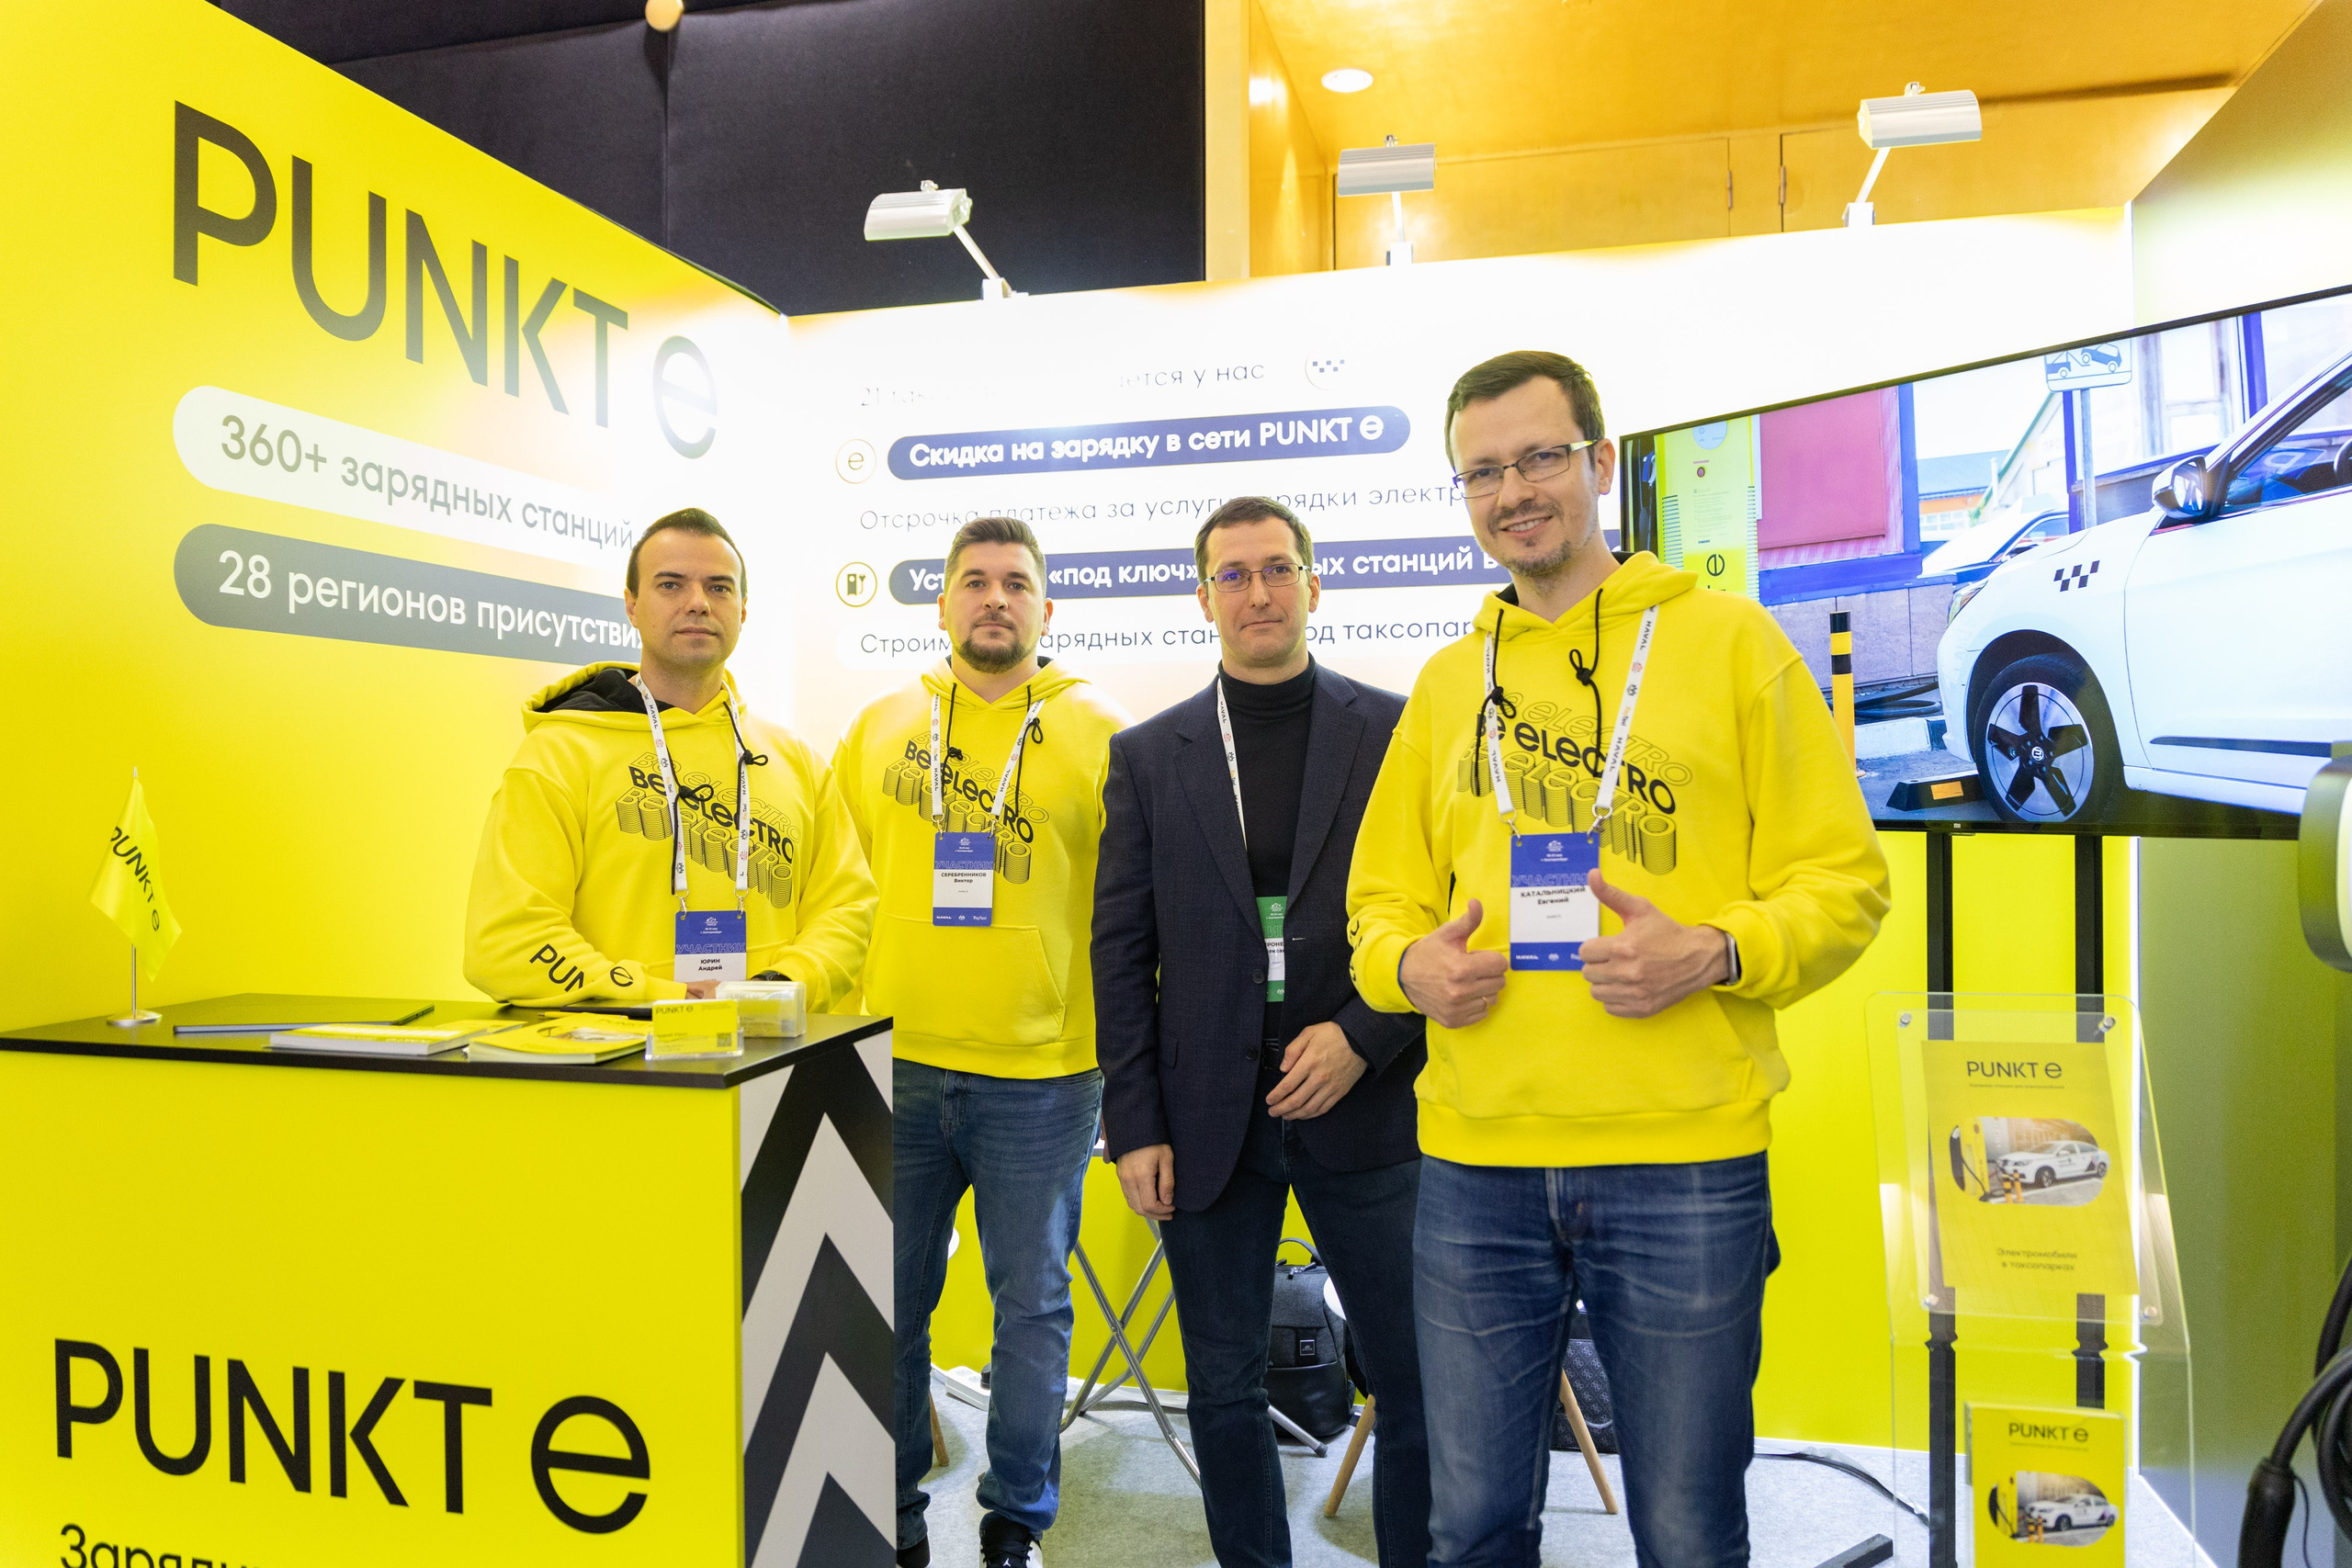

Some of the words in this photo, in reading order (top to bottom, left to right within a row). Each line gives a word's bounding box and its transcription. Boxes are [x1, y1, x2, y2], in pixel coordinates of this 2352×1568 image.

[174, 99, 628, 429] PUNKT
[652, 334, 718, 459] e
[1193, 368, 1206, 389] у
[1216, 364, 1265, 382] нас
[909, 442, 1004, 468] Скидка
[1012, 440, 1045, 461] на
[1050, 434, 1160, 462] зарядку
[1166, 434, 1182, 452] в
[1188, 429, 1250, 451] сети
[1259, 416, 1353, 446] PUNKT
[220, 414, 328, 475] 360+
[340, 455, 513, 524] зарядных
[860, 510, 978, 533] Отсрочка
[1107, 500, 1136, 518] за
[1274, 491, 1357, 511] рядки
[1369, 486, 1463, 507] электр
[909, 568, 945, 592] Уст
[1047, 566, 1113, 589] «под
[1118, 563, 1198, 584] ключ»
[1311, 556, 1346, 576] ых
[1352, 545, 1474, 576] станций
[218, 548, 273, 599] 28
[288, 568, 466, 626] регионов
[861, 634, 952, 658] Строим
[1039, 631, 1154, 653] арядных
[1162, 628, 1220, 646] стан
[1306, 625, 1336, 645] од
[1342, 620, 1471, 640] таксопар
[1640, 620, 1652, 650] HAVAL
[649, 704, 659, 729] HAVAL
[1492, 749, 1501, 783] HAVAL
[1609, 736, 1623, 773] HAVAL
[1000, 768, 1011, 793] HAVAL
[1511, 872, 1589, 886] УЧАСТНИ
[675, 942, 746, 954] УЧАСТНИК
[529, 943, 585, 992] PUN
[655, 1006, 684, 1015] PUNKT
[1966, 1060, 2039, 1078] PUNKT
[55, 1337, 493, 1516] PUNKT
[530, 1394, 651, 1536] e
[2008, 1422, 2070, 1440] PUNKT
